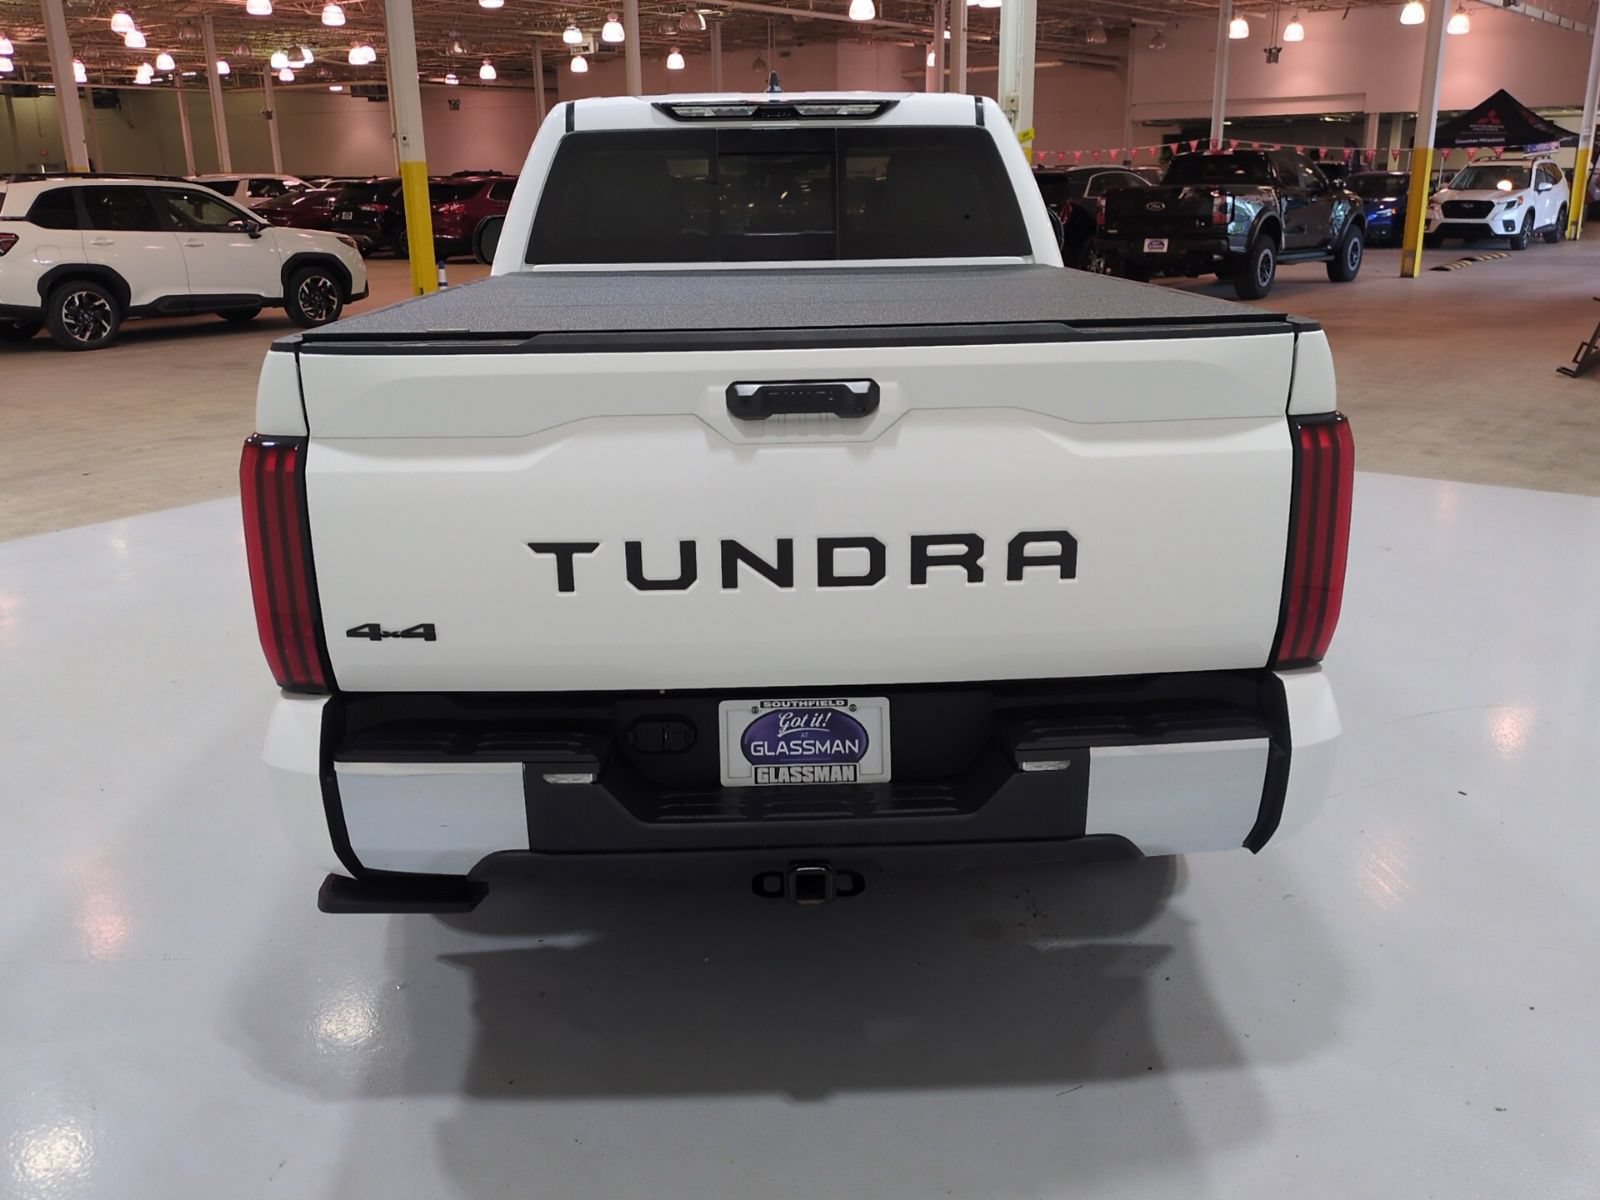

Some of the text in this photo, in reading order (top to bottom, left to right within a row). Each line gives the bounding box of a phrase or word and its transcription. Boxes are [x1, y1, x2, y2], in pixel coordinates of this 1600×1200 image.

[527, 530, 1078, 593] TUNDRA
[346, 623, 437, 642] 4x4
[763, 700, 845, 708] SOUTHFIELD
[778, 712, 832, 731] Got it!
[750, 739, 859, 756] GLASSMAN
[756, 765, 855, 784] GLASSMAN
